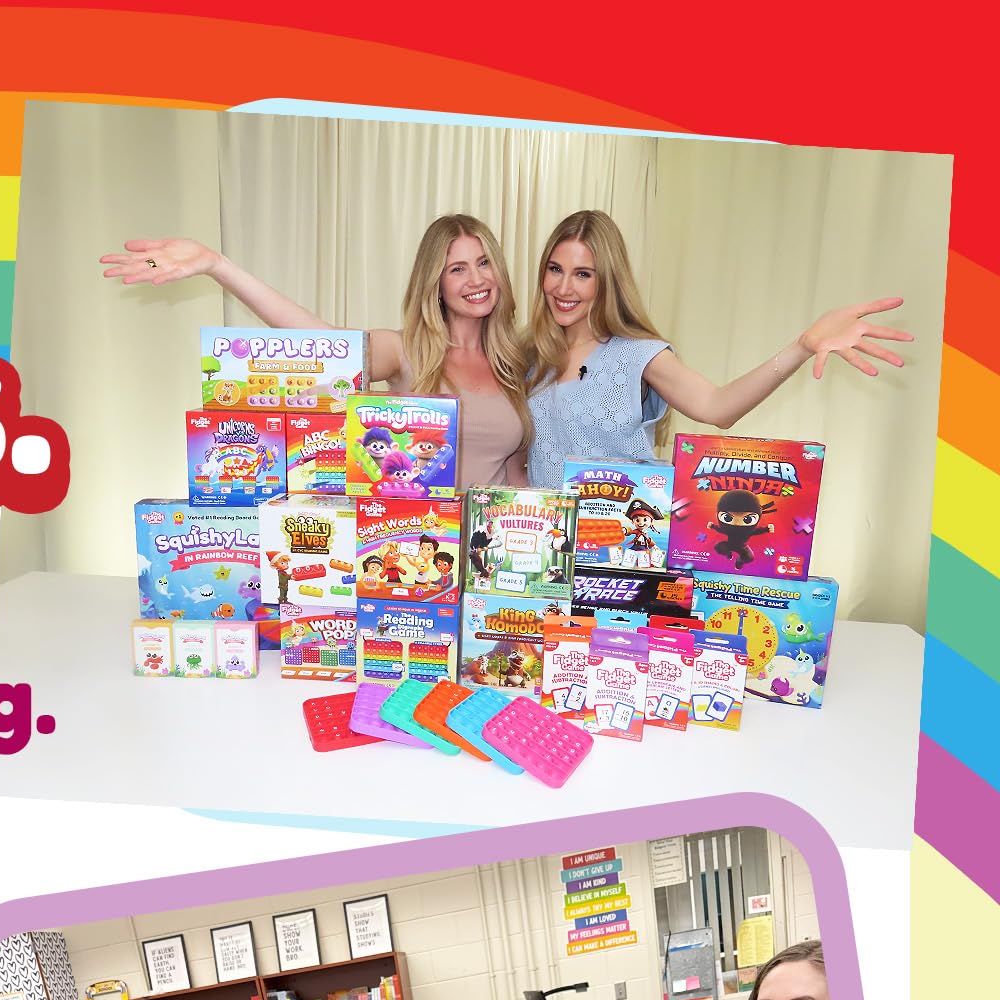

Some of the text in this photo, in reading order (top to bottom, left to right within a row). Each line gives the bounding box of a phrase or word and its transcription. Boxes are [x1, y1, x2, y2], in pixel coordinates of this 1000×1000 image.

[213, 337, 349, 359] POPPLERS
[254, 362, 280, 370] FARM
[218, 418, 256, 435] UNICORNS
[213, 433, 260, 444] DRAGONS
[303, 430, 331, 446] ABC
[226, 447, 248, 455] ABC
[301, 439, 342, 458] BINGO!
[694, 456, 799, 484] NUMBER
[584, 471, 623, 482] MATH
[578, 484, 630, 498] AHOY!
[709, 476, 785, 496] NINJA
[360, 505, 387, 514] Fidget
[482, 504, 564, 525] VOCABULARY
[285, 517, 331, 538] Sneaky
[358, 516, 423, 538] Sight Words
[500, 520, 544, 531] VULTURES
[291, 531, 328, 548] Elves
[184, 553, 259, 563] IN RAINBOW REEF
[574, 576, 645, 590] ROCKET
[583, 589, 640, 601] RACE
[693, 579, 733, 593] Squishy
[733, 582, 761, 595] Time
[761, 586, 801, 600] Rescue
[751, 598, 767, 606] TIME
[383, 614, 434, 629] Reading
[723, 611, 732, 621] 11
[755, 615, 760, 624] 1
[309, 620, 357, 633] WORD
[711, 620, 723, 629] 10
[389, 626, 426, 639] Game
[763, 626, 771, 635] 2
[765, 639, 773, 648] 3
[570, 651, 585, 660] The
[759, 651, 767, 660] 4
[561, 664, 585, 672] Game
[661, 661, 676, 671] The
[715, 660, 731, 670] The
[748, 659, 755, 667] 5
[615, 668, 631, 677] The
[696, 661, 736, 677] Fidget
[597, 669, 637, 686] Fidget
[652, 672, 677, 683] Game
[704, 671, 730, 681] Game
[605, 680, 631, 691] Game
[597, 690, 629, 698] ADDITION
[595, 695, 637, 705] SUBTRACTION
[585, 851, 607, 862] UNIQUE
[591, 866, 605, 875] GIVE
[599, 913, 617, 923] LOVED
[580, 927, 605, 939] FEELINGS
[606, 923, 627, 934] MATTER
